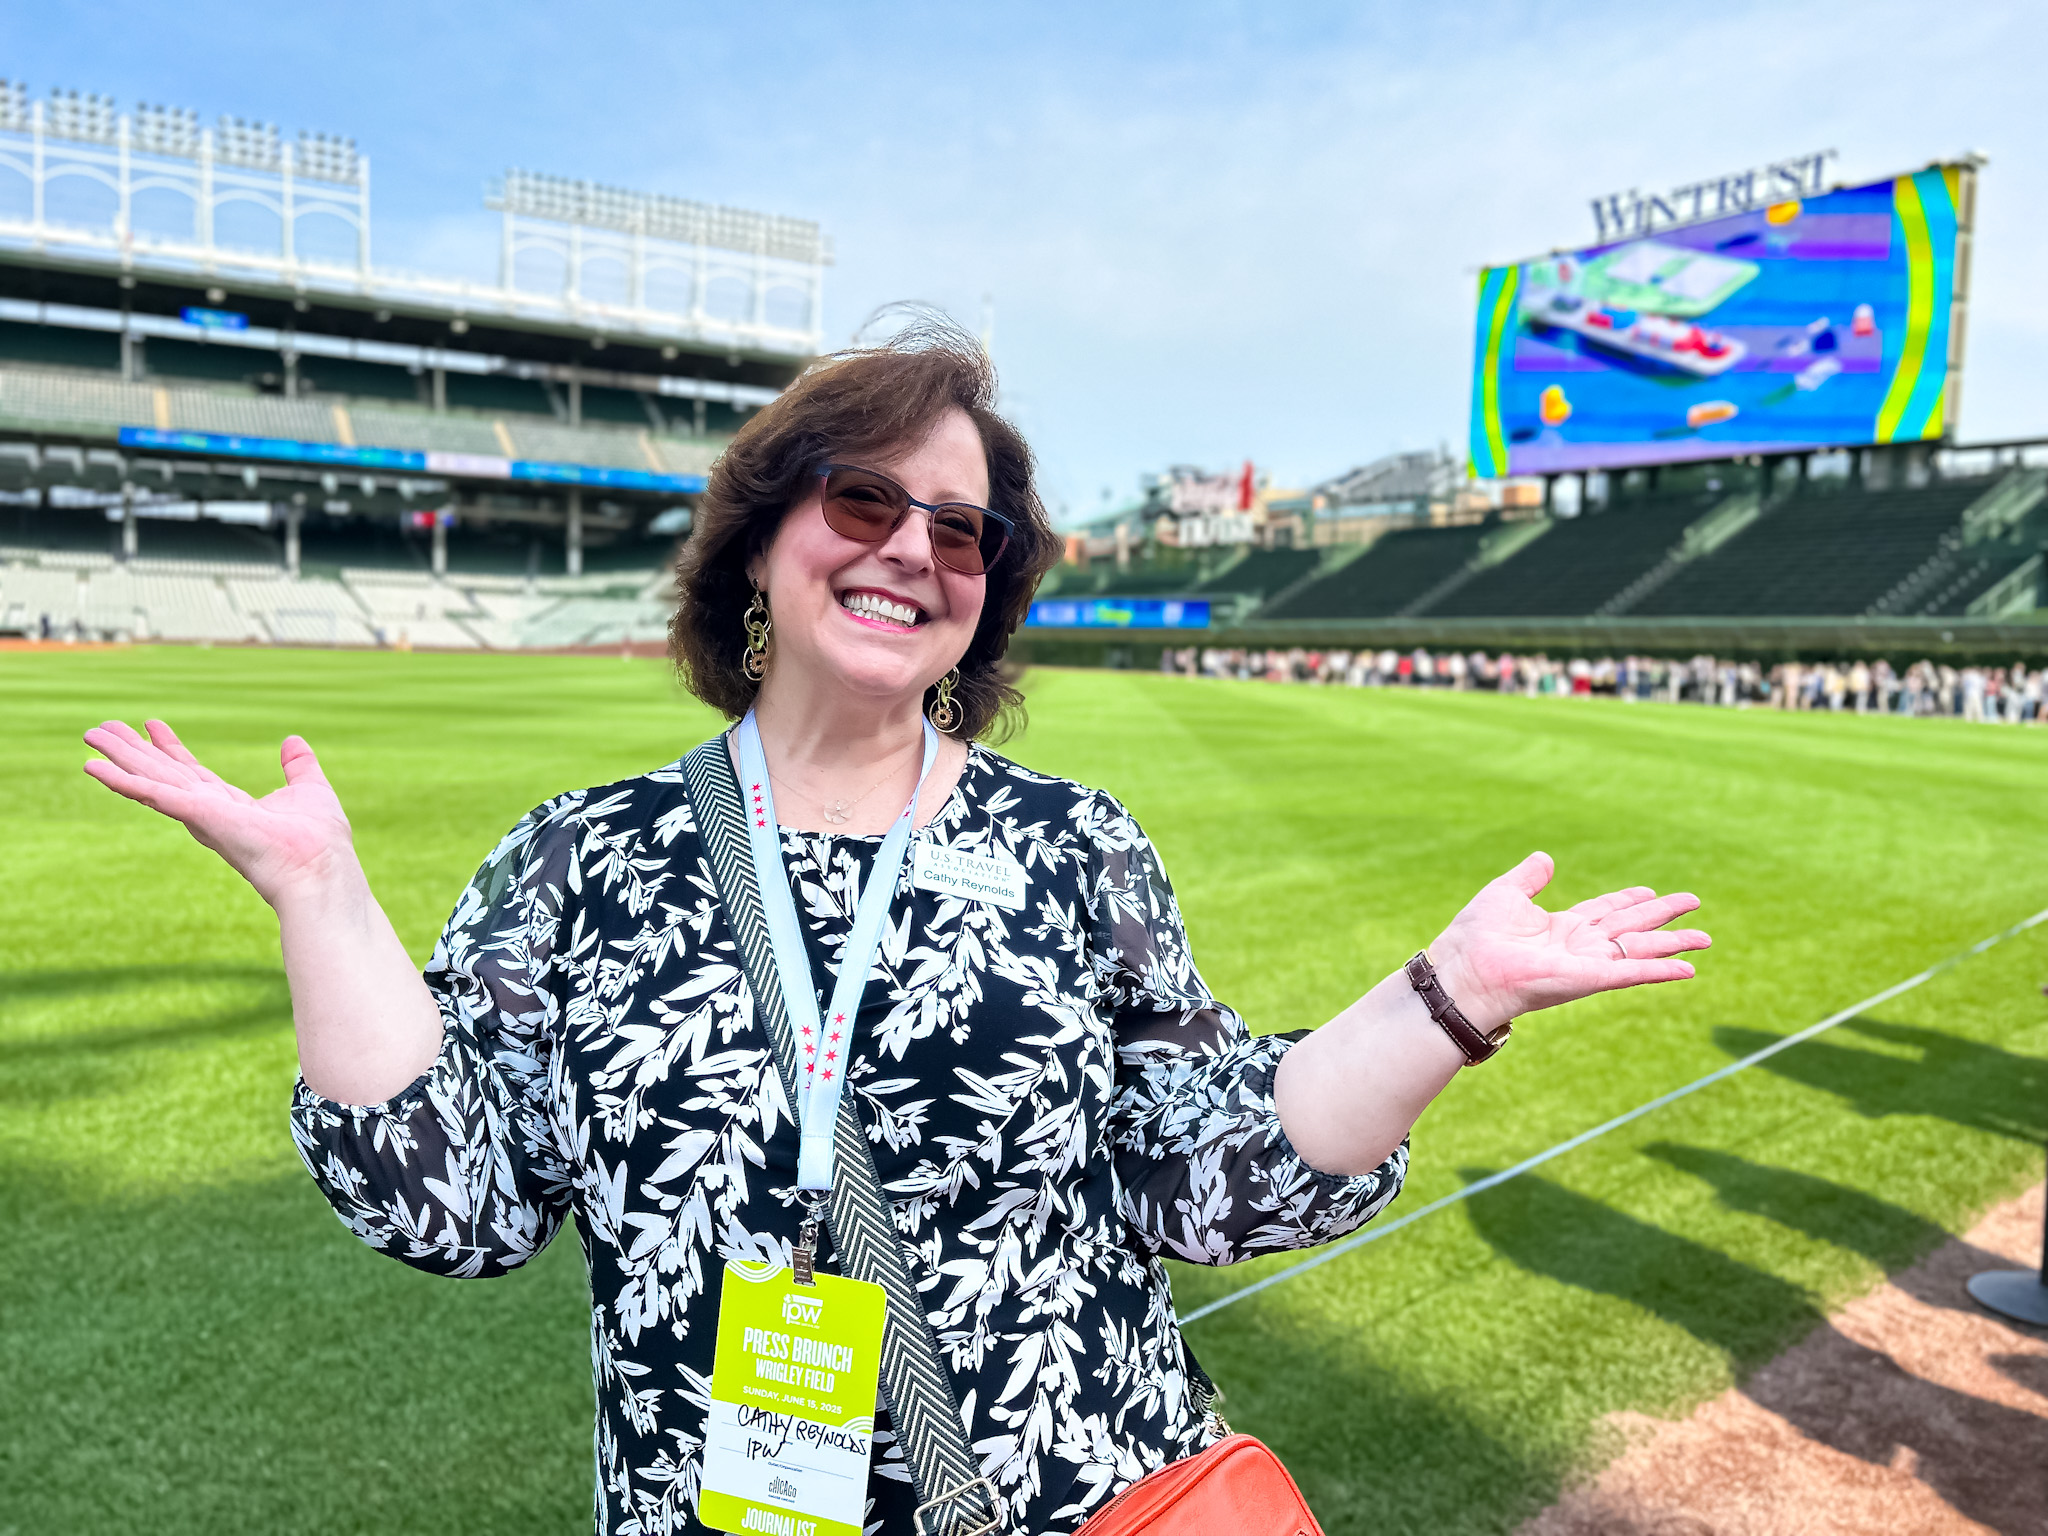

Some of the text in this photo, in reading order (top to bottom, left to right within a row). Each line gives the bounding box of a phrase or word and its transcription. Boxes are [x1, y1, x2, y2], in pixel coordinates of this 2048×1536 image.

[930, 850, 1011, 877] U.S. TRAVEL
[923, 869, 1015, 898] Cathy Reynolds
[781, 1294, 822, 1325] ipw
[742, 1326, 854, 1374] PRESS BRUNCH
[755, 1357, 835, 1393] WRIGLEY FIELD
[742, 1385, 842, 1414] SUNDAY, JUNE 15, 2025
[737, 1404, 867, 1456] CATHY REYNOLDS
[746, 1437, 784, 1460] IPW
[768, 1475, 798, 1498] CHICAGO
[741, 1506, 817, 1536] JOURNALIST
